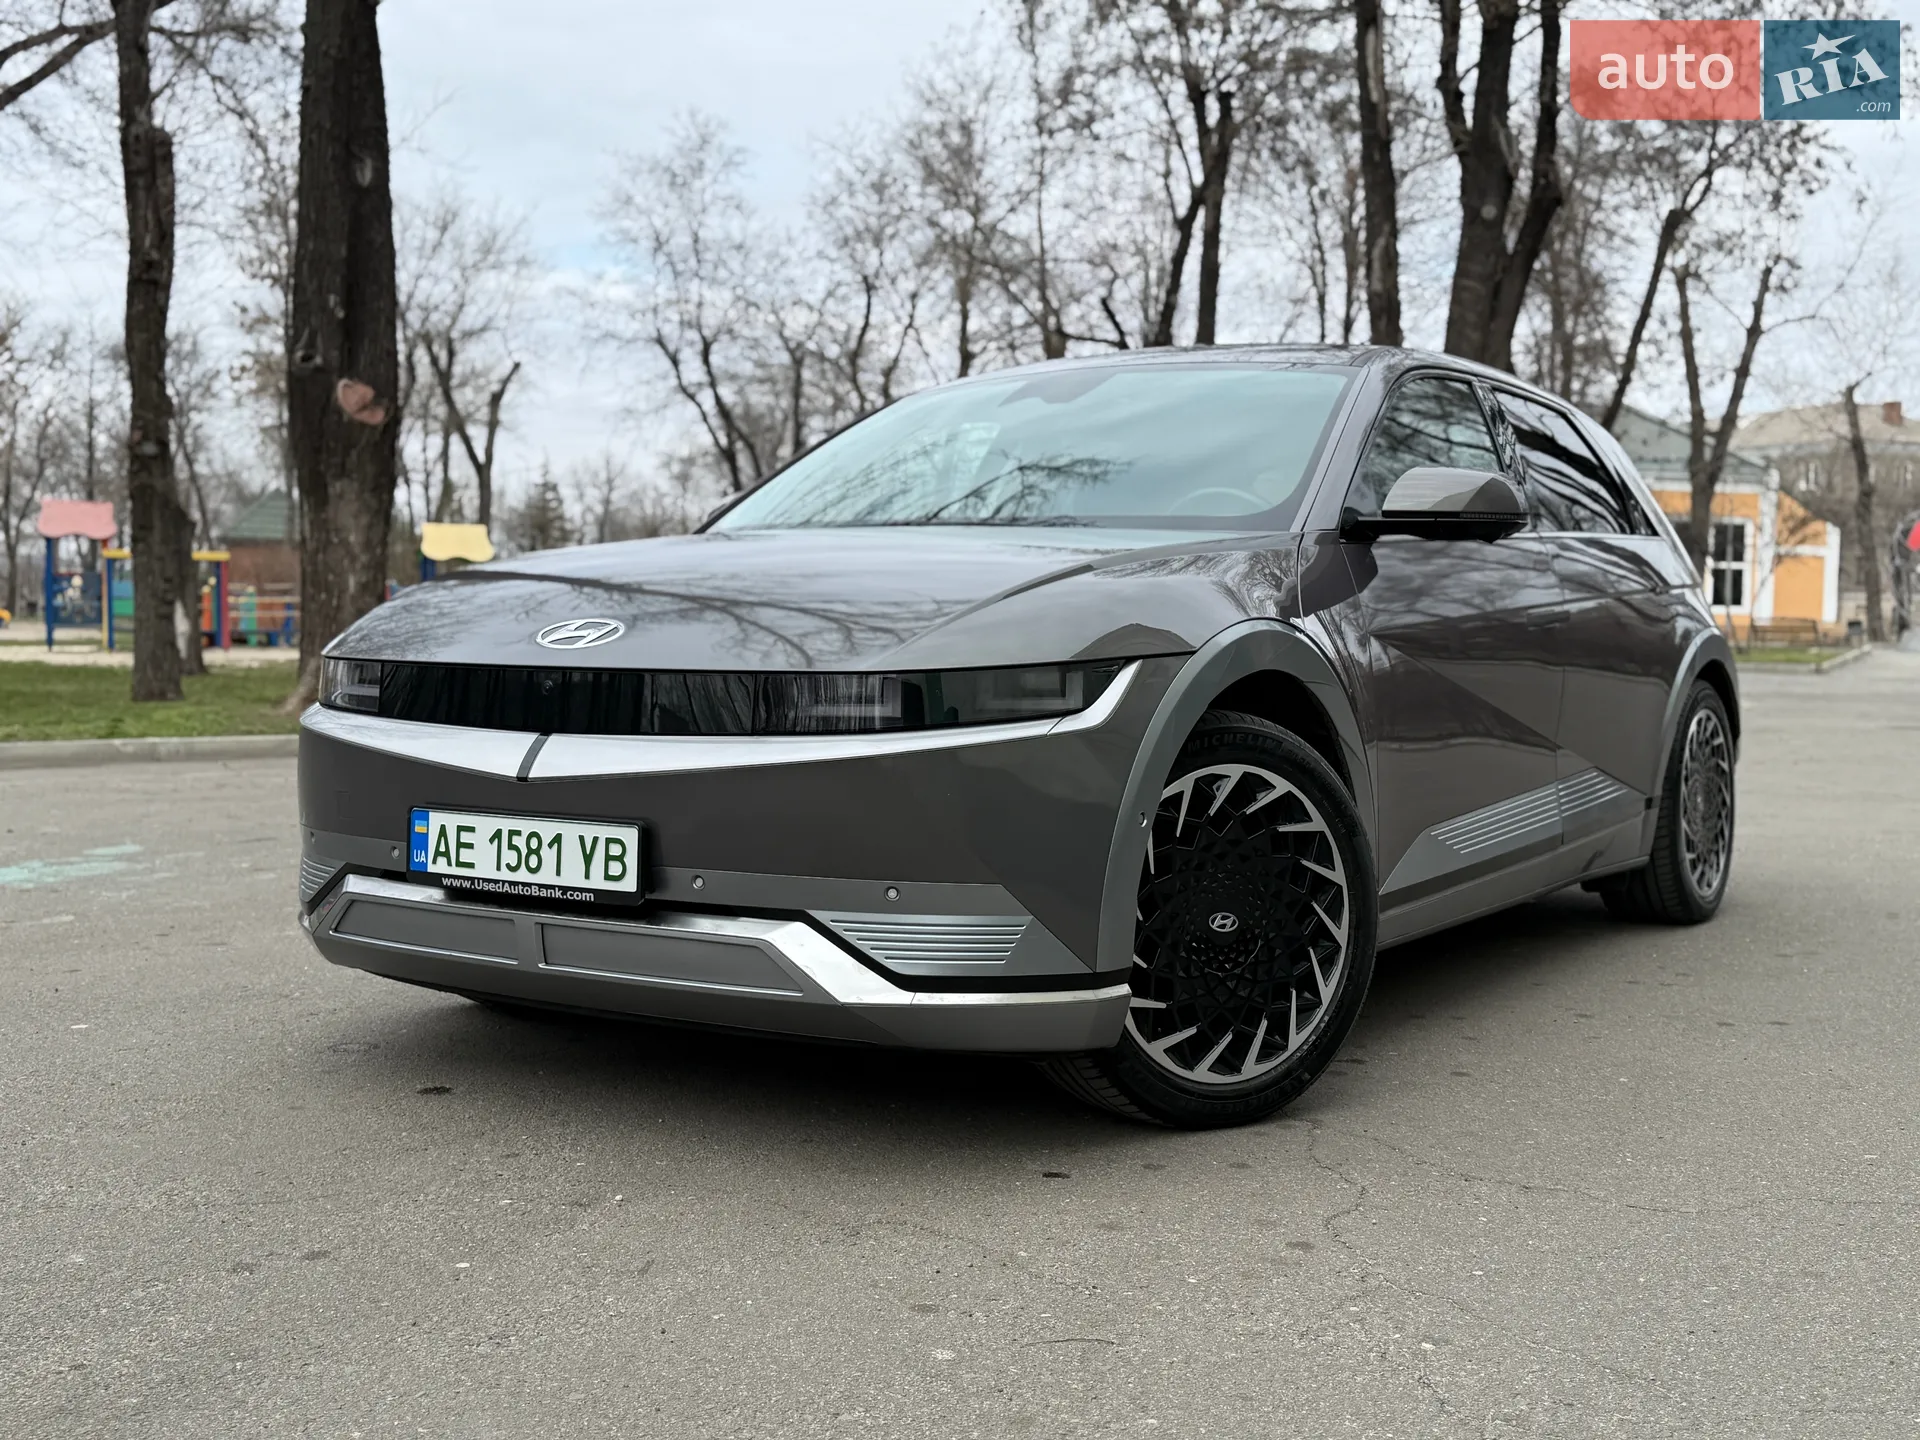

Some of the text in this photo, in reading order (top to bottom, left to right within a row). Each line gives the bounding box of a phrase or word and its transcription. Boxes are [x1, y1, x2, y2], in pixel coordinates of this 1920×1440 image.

[413, 849, 427, 864] UA
[432, 823, 628, 882] AE 1581 YB
[441, 876, 595, 902] www.UsedAutoBank.com
